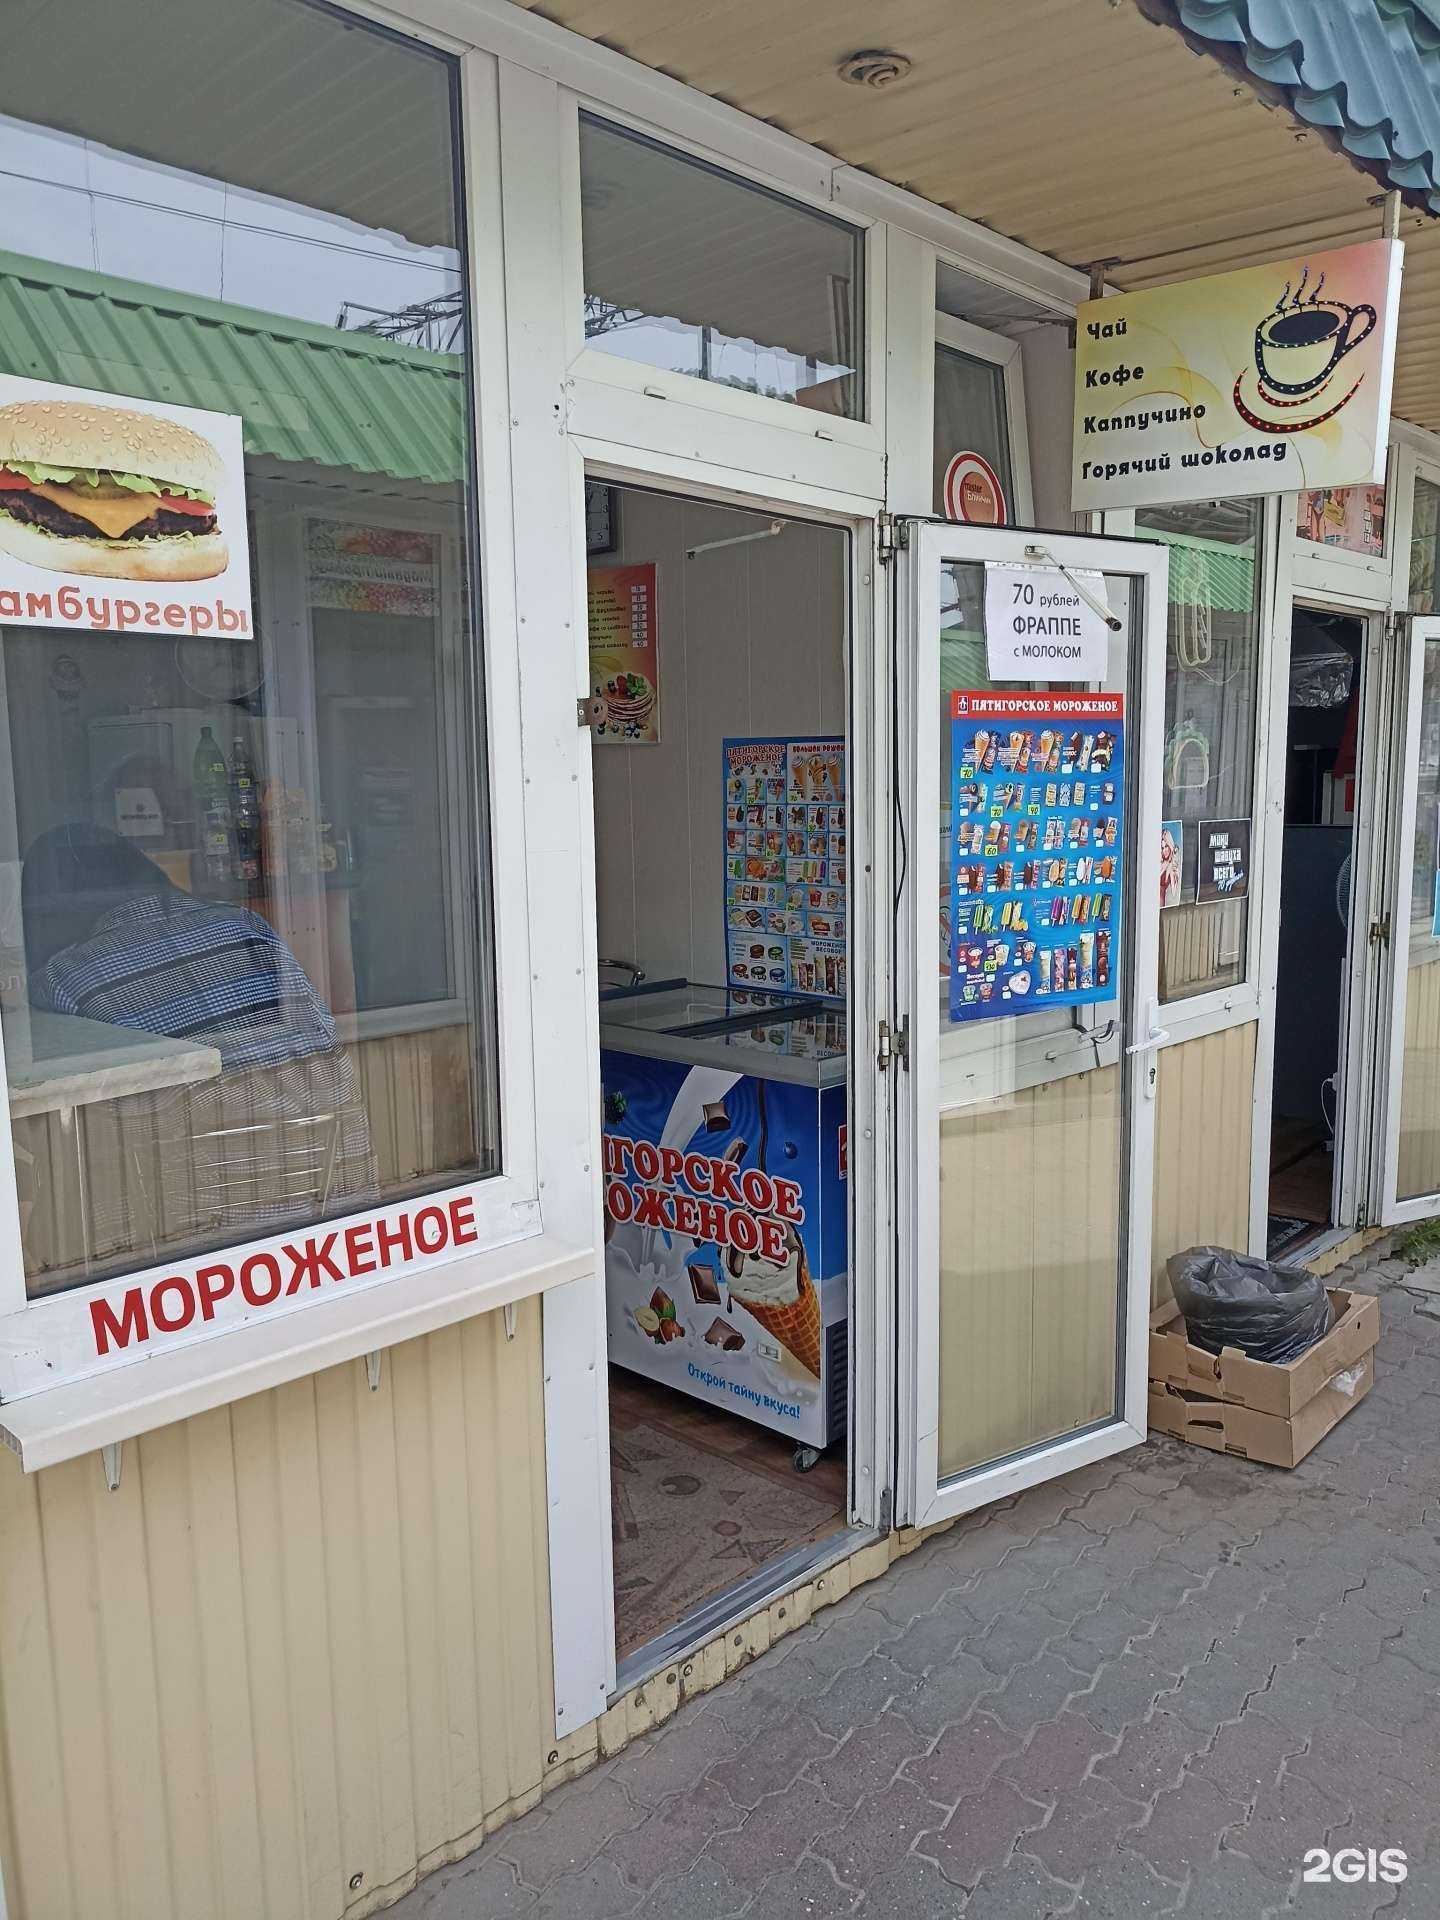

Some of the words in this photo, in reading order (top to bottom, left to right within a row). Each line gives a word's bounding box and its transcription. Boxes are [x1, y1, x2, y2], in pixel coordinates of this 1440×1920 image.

[1086, 317, 1128, 340] Чай
[1085, 364, 1145, 388] Кофе
[1083, 404, 1206, 434] Каппучино
[1081, 453, 1171, 480] Горячий
[1180, 441, 1288, 466] шоколад
[1013, 583, 1034, 605] 70
[1040, 594, 1080, 608] рублей
[0, 585, 248, 635] амбургеры
[1012, 615, 1082, 636] ФРАППЕ
[1013, 648, 1019, 658] с
[1022, 645, 1082, 658] МОЛОКОМ
[971, 699, 1051, 712] ПЯТИГОРСКОЕ
[1053, 700, 1118, 712] МОРОЖЕНОЕ
[88, 1196, 479, 1356] МОРОЖЕНОЕ
[688, 1361, 726, 1389] Открой
[728, 1381, 762, 1407] тайну
[763, 1395, 800, 1420] вкуса!
